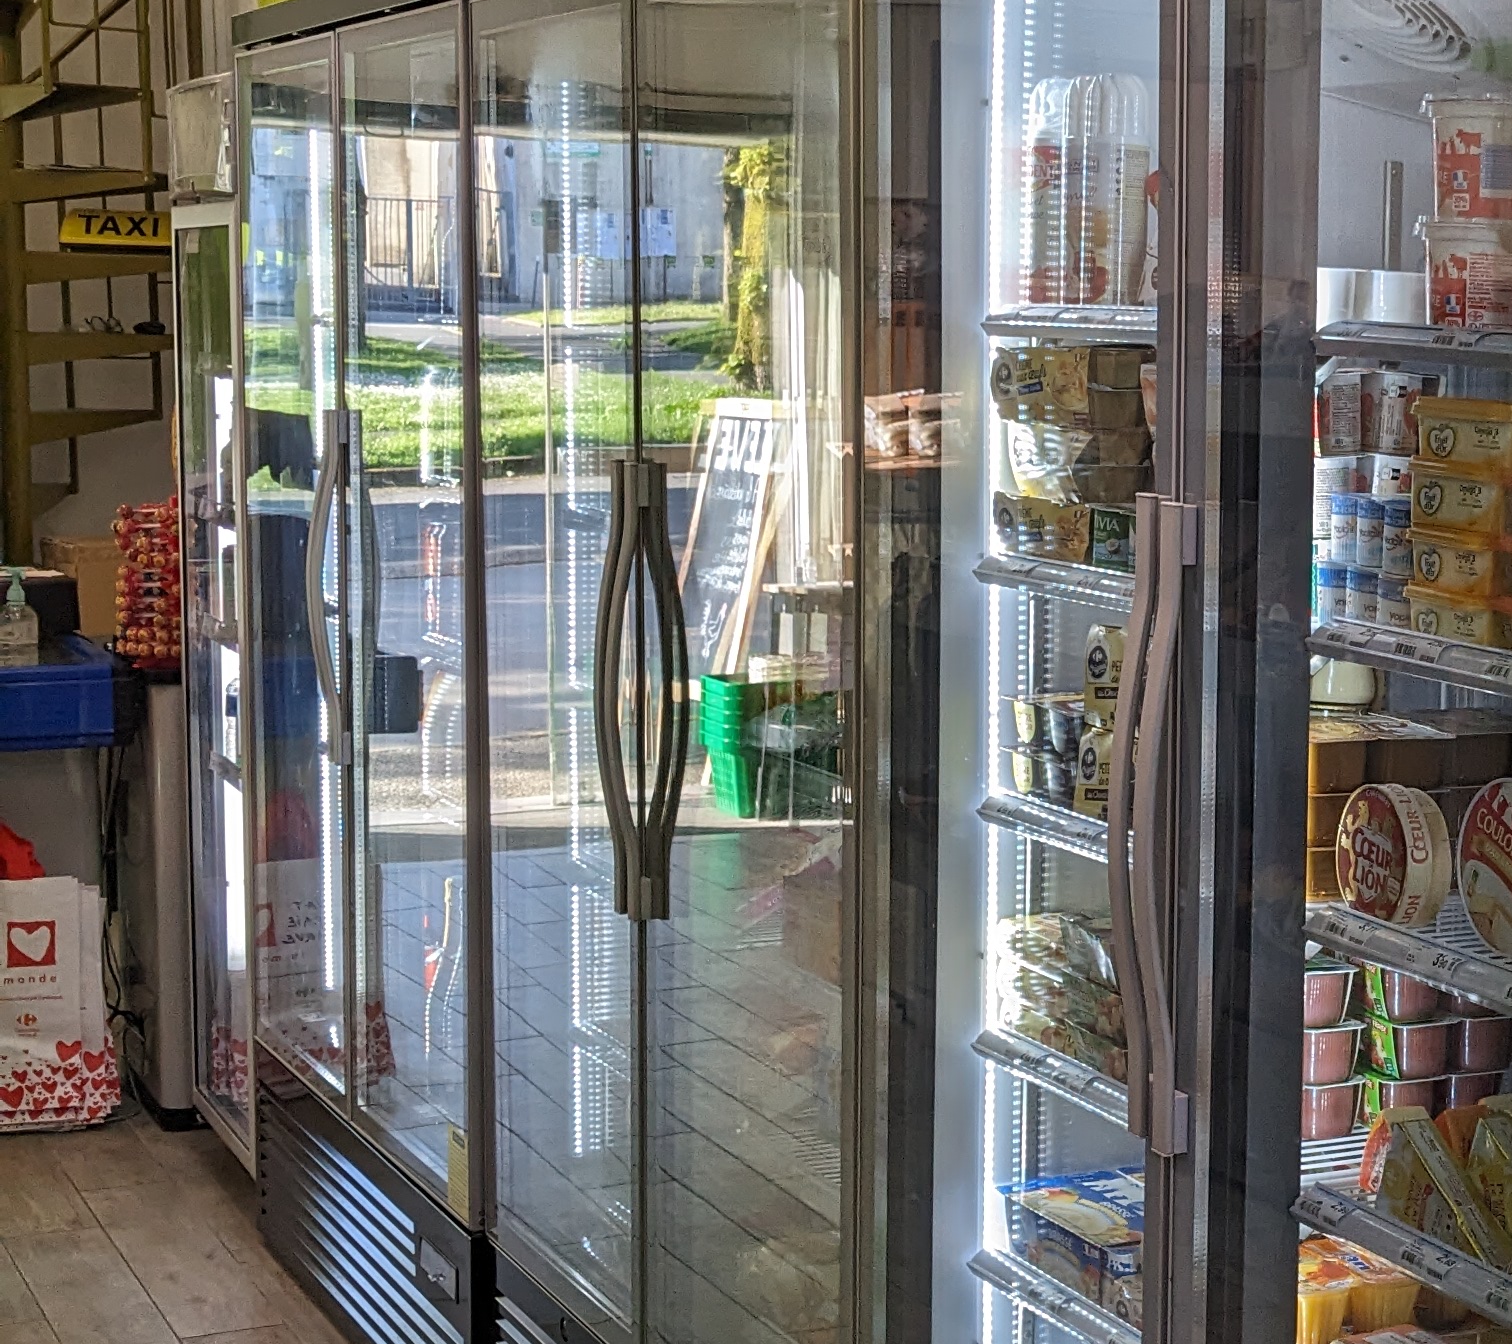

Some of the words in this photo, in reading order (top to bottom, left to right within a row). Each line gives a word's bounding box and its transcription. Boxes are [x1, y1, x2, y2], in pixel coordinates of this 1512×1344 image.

[78, 213, 159, 237] TAXI
[1351, 826, 1393, 869] CŒUR
[1409, 809, 1430, 866] CŒUR
[1351, 865, 1386, 895] LION
